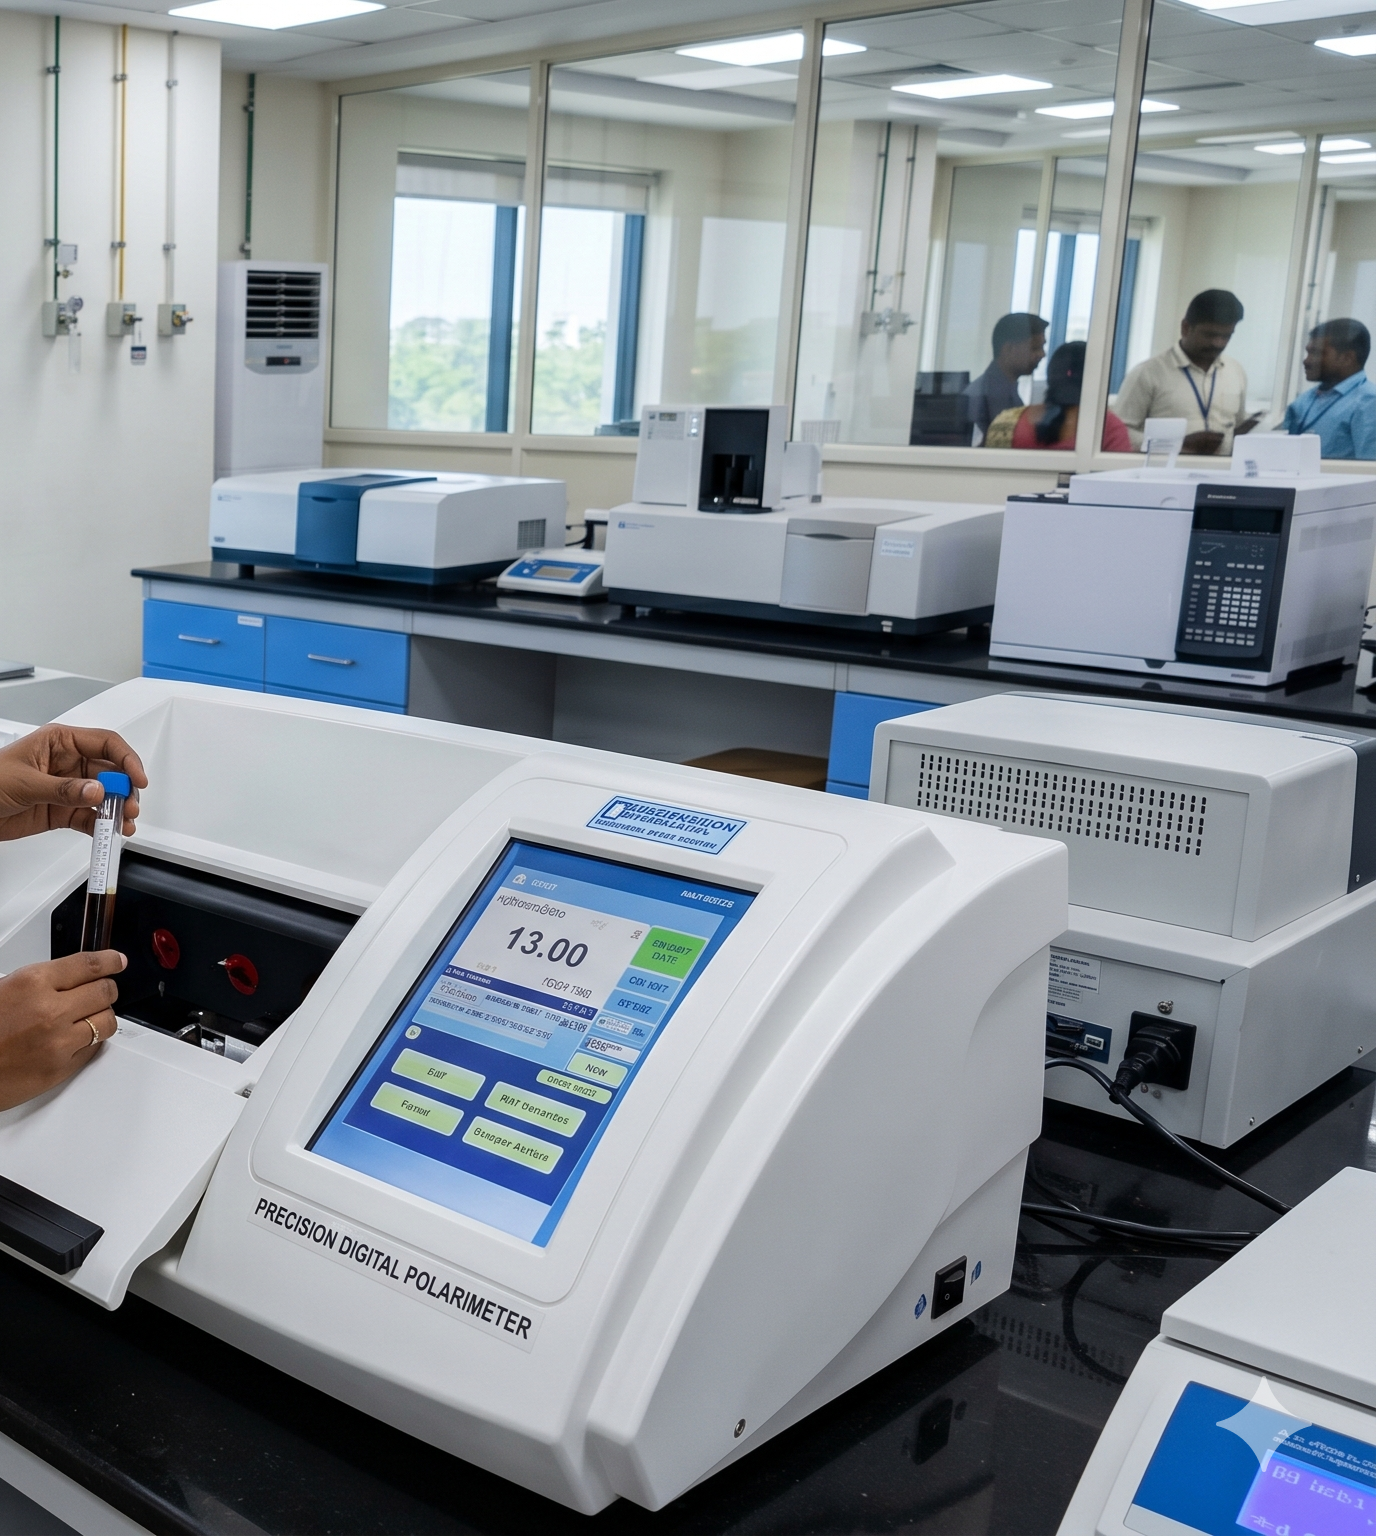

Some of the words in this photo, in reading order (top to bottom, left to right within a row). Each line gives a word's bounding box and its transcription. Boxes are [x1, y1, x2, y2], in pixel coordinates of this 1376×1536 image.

[506, 926, 589, 968] 13.00
[652, 951, 679, 965] DATE
[254, 1197, 338, 1250] PRECISION
[338, 1235, 401, 1280] DIGITAL
[403, 1265, 532, 1340] POLARIMETER
